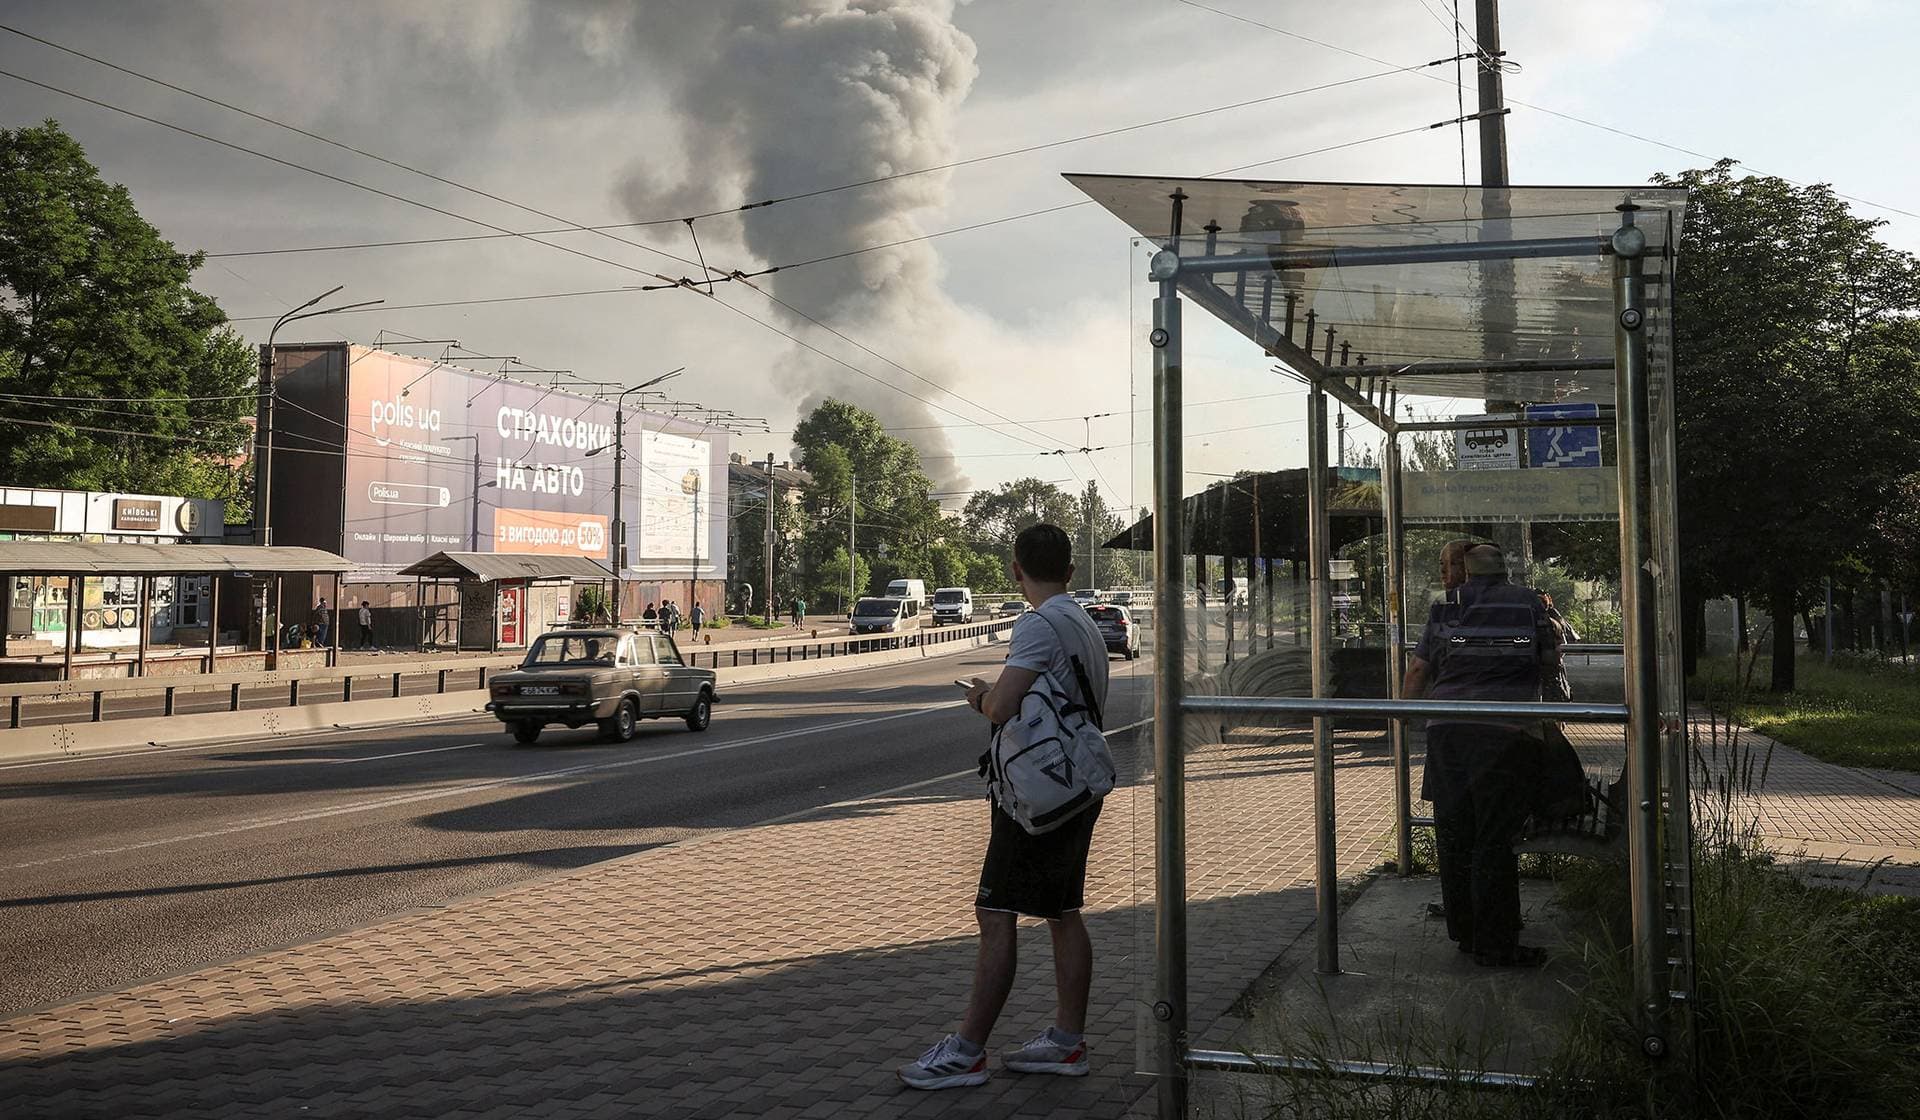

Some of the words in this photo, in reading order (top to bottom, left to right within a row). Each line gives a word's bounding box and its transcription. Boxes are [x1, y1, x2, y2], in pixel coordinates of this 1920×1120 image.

[371, 395, 414, 433] polis
[418, 407, 441, 432] ua
[497, 406, 612, 453] СТРАХОВКИ
[496, 457, 527, 491] НА
[532, 462, 584, 497] АВТО
[373, 486, 400, 499] Polis.ua
[122, 507, 157, 517] КИЇВСЬКІ
[354, 532, 376, 542] Онлайн
[383, 533, 409, 543] Широкий
[410, 534, 425, 545] вибір
[499, 526, 506, 542] З
[508, 525, 559, 546] ВИГОДОЮ
[580, 526, 601, 545] 50%
